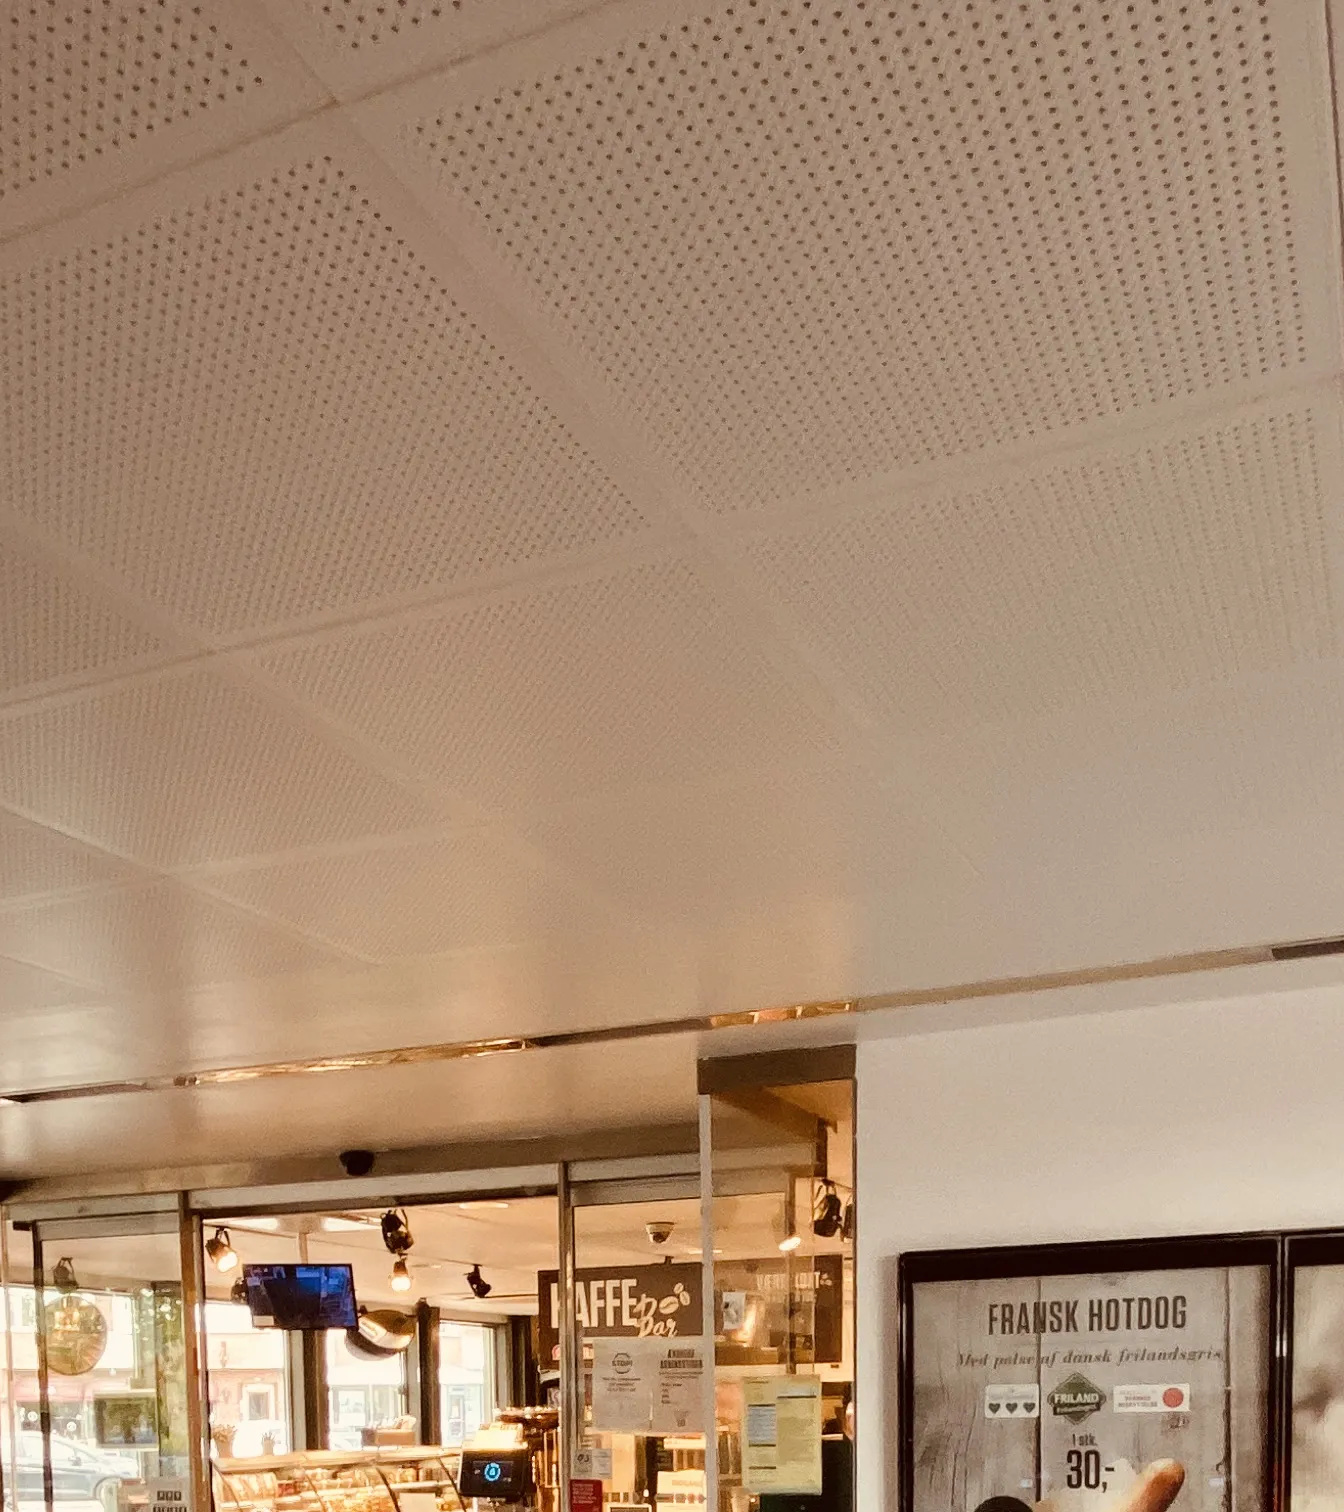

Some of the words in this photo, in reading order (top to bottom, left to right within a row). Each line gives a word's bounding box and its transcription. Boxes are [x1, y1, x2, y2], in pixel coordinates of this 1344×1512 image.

[988, 1300, 1079, 1336] FRANSK
[1088, 1295, 1188, 1332] HOTDOG
[1062, 1349, 1112, 1365] dansk
[1116, 1346, 1222, 1368] frilandsgris
[1054, 1391, 1101, 1404] FRILAND
[1066, 1449, 1115, 1493] 30,-
